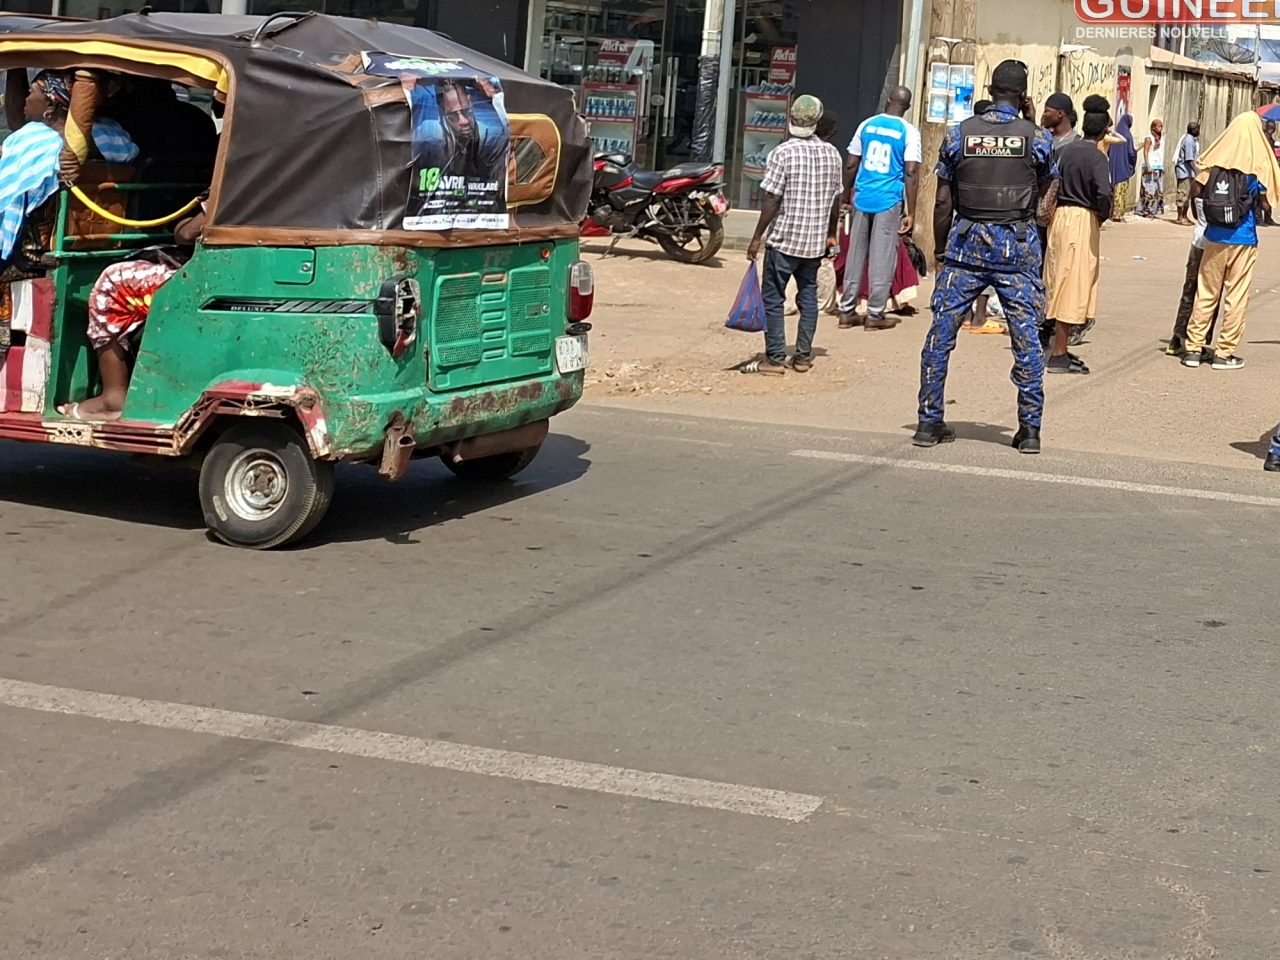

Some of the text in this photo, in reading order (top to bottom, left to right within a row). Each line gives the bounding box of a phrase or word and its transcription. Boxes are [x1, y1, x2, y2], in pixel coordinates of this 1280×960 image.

[967, 136, 1022, 148] PSIG
[975, 147, 1012, 156] RATOMA
[439, 175, 466, 190] AVRIL
